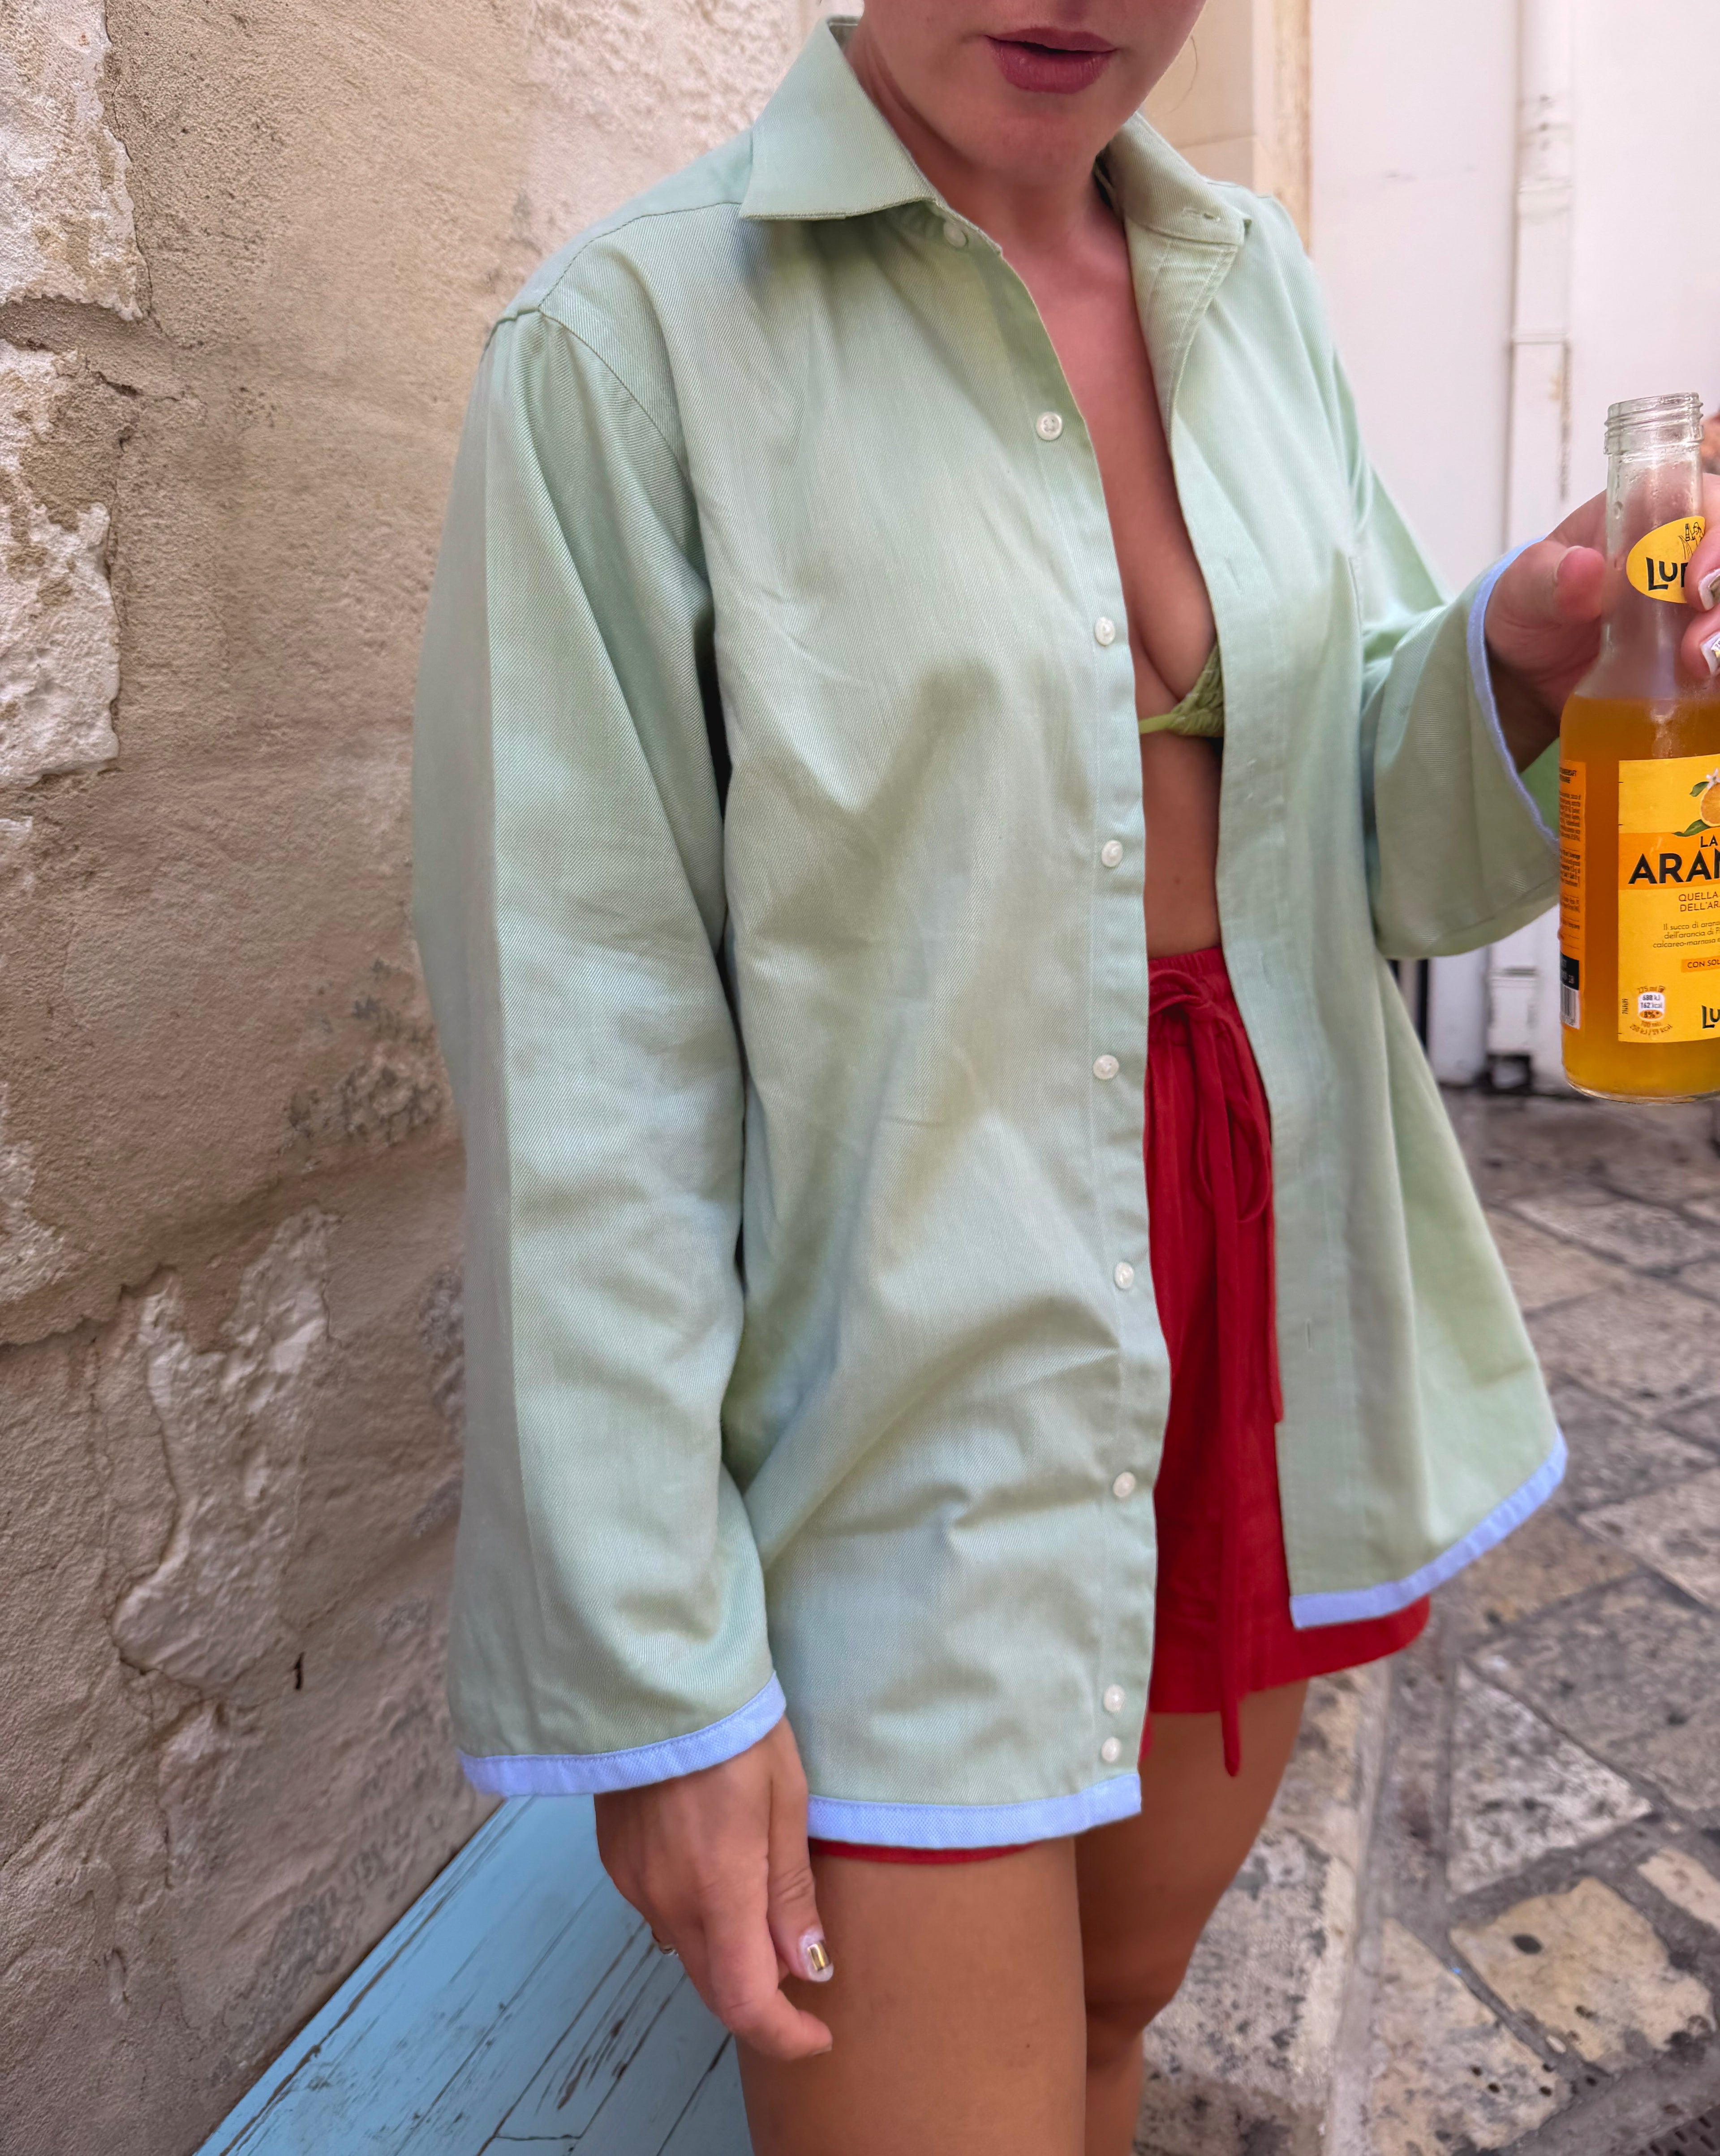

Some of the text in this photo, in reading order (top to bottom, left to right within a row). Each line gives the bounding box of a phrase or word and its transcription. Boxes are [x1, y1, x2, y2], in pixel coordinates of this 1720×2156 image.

[1700, 835, 1718, 848] LA
[1679, 891, 1718, 902] QUELLA
[1680, 901, 1720, 912] DELL'AR
[1664, 930, 1705, 939] dell'arancia
